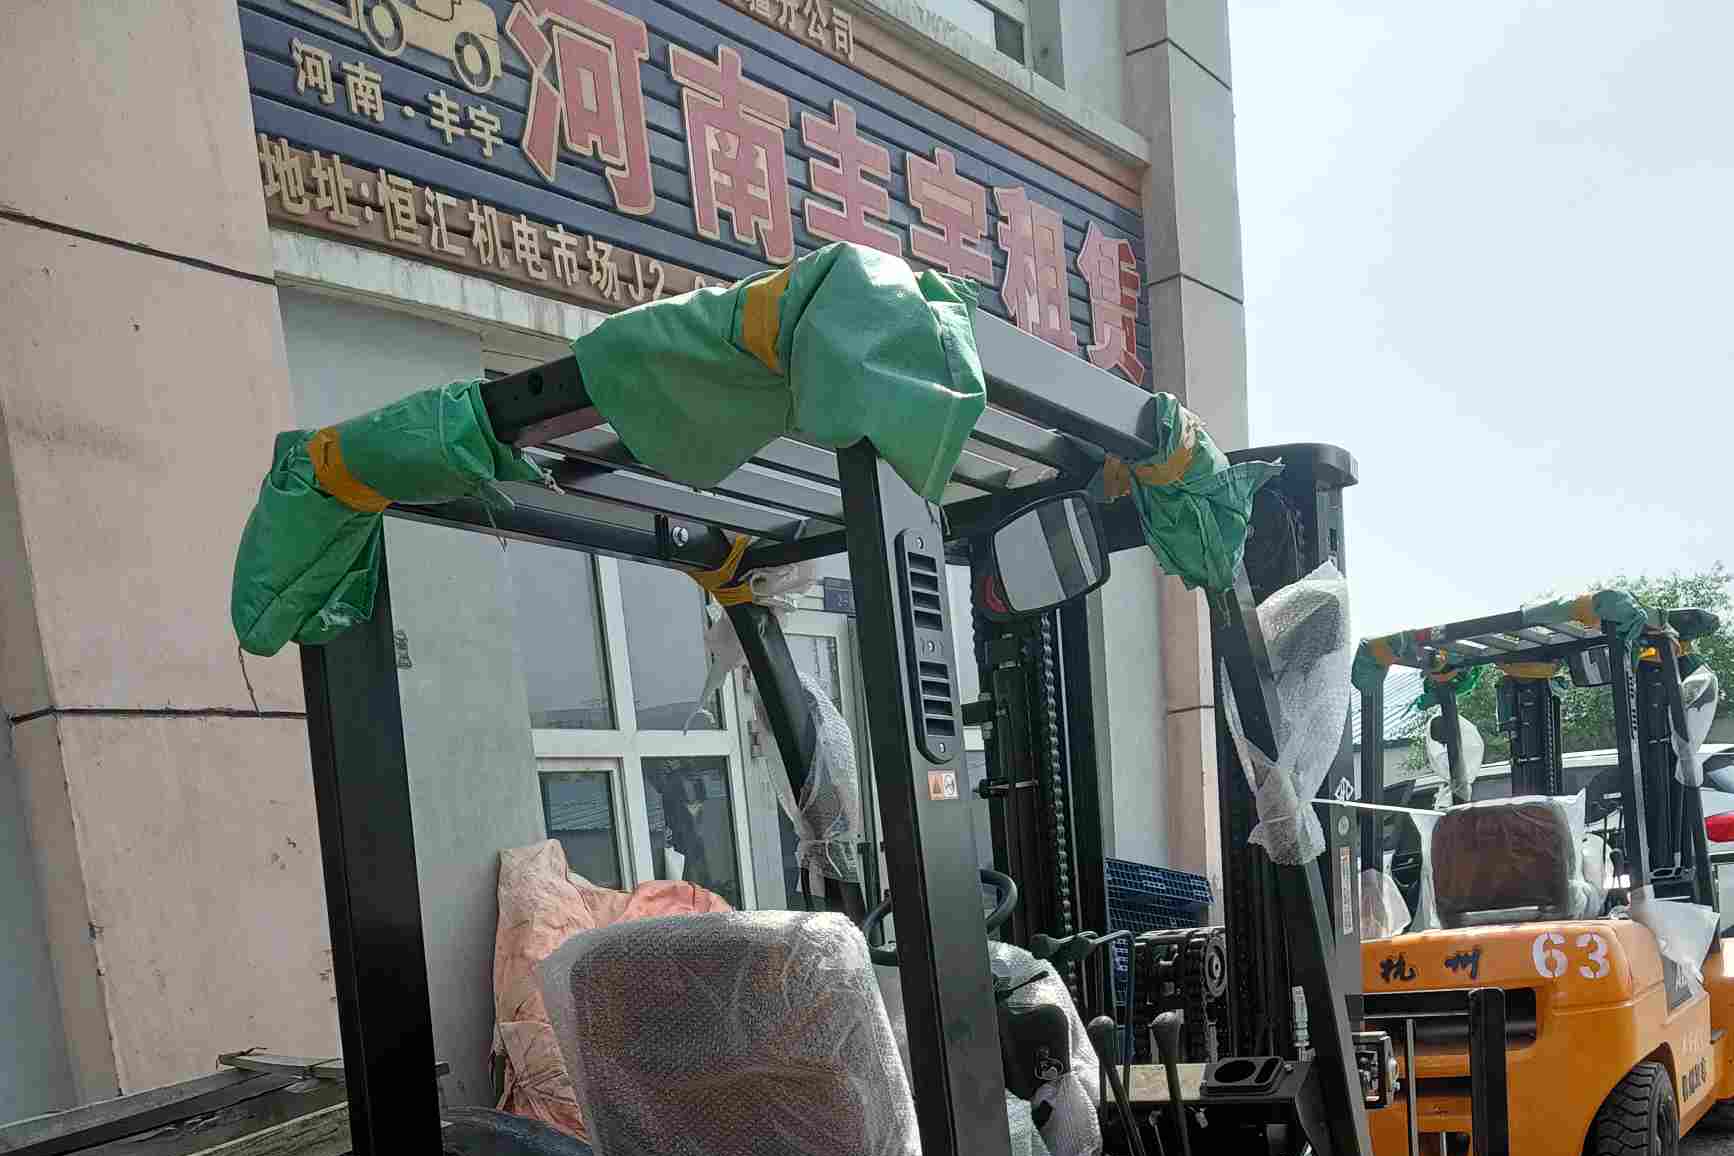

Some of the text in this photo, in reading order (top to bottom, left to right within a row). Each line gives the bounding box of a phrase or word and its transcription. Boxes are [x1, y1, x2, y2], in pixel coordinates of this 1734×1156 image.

[288, 37, 503, 158] 河南·丰宇
[1532, 930, 1611, 980] 63
